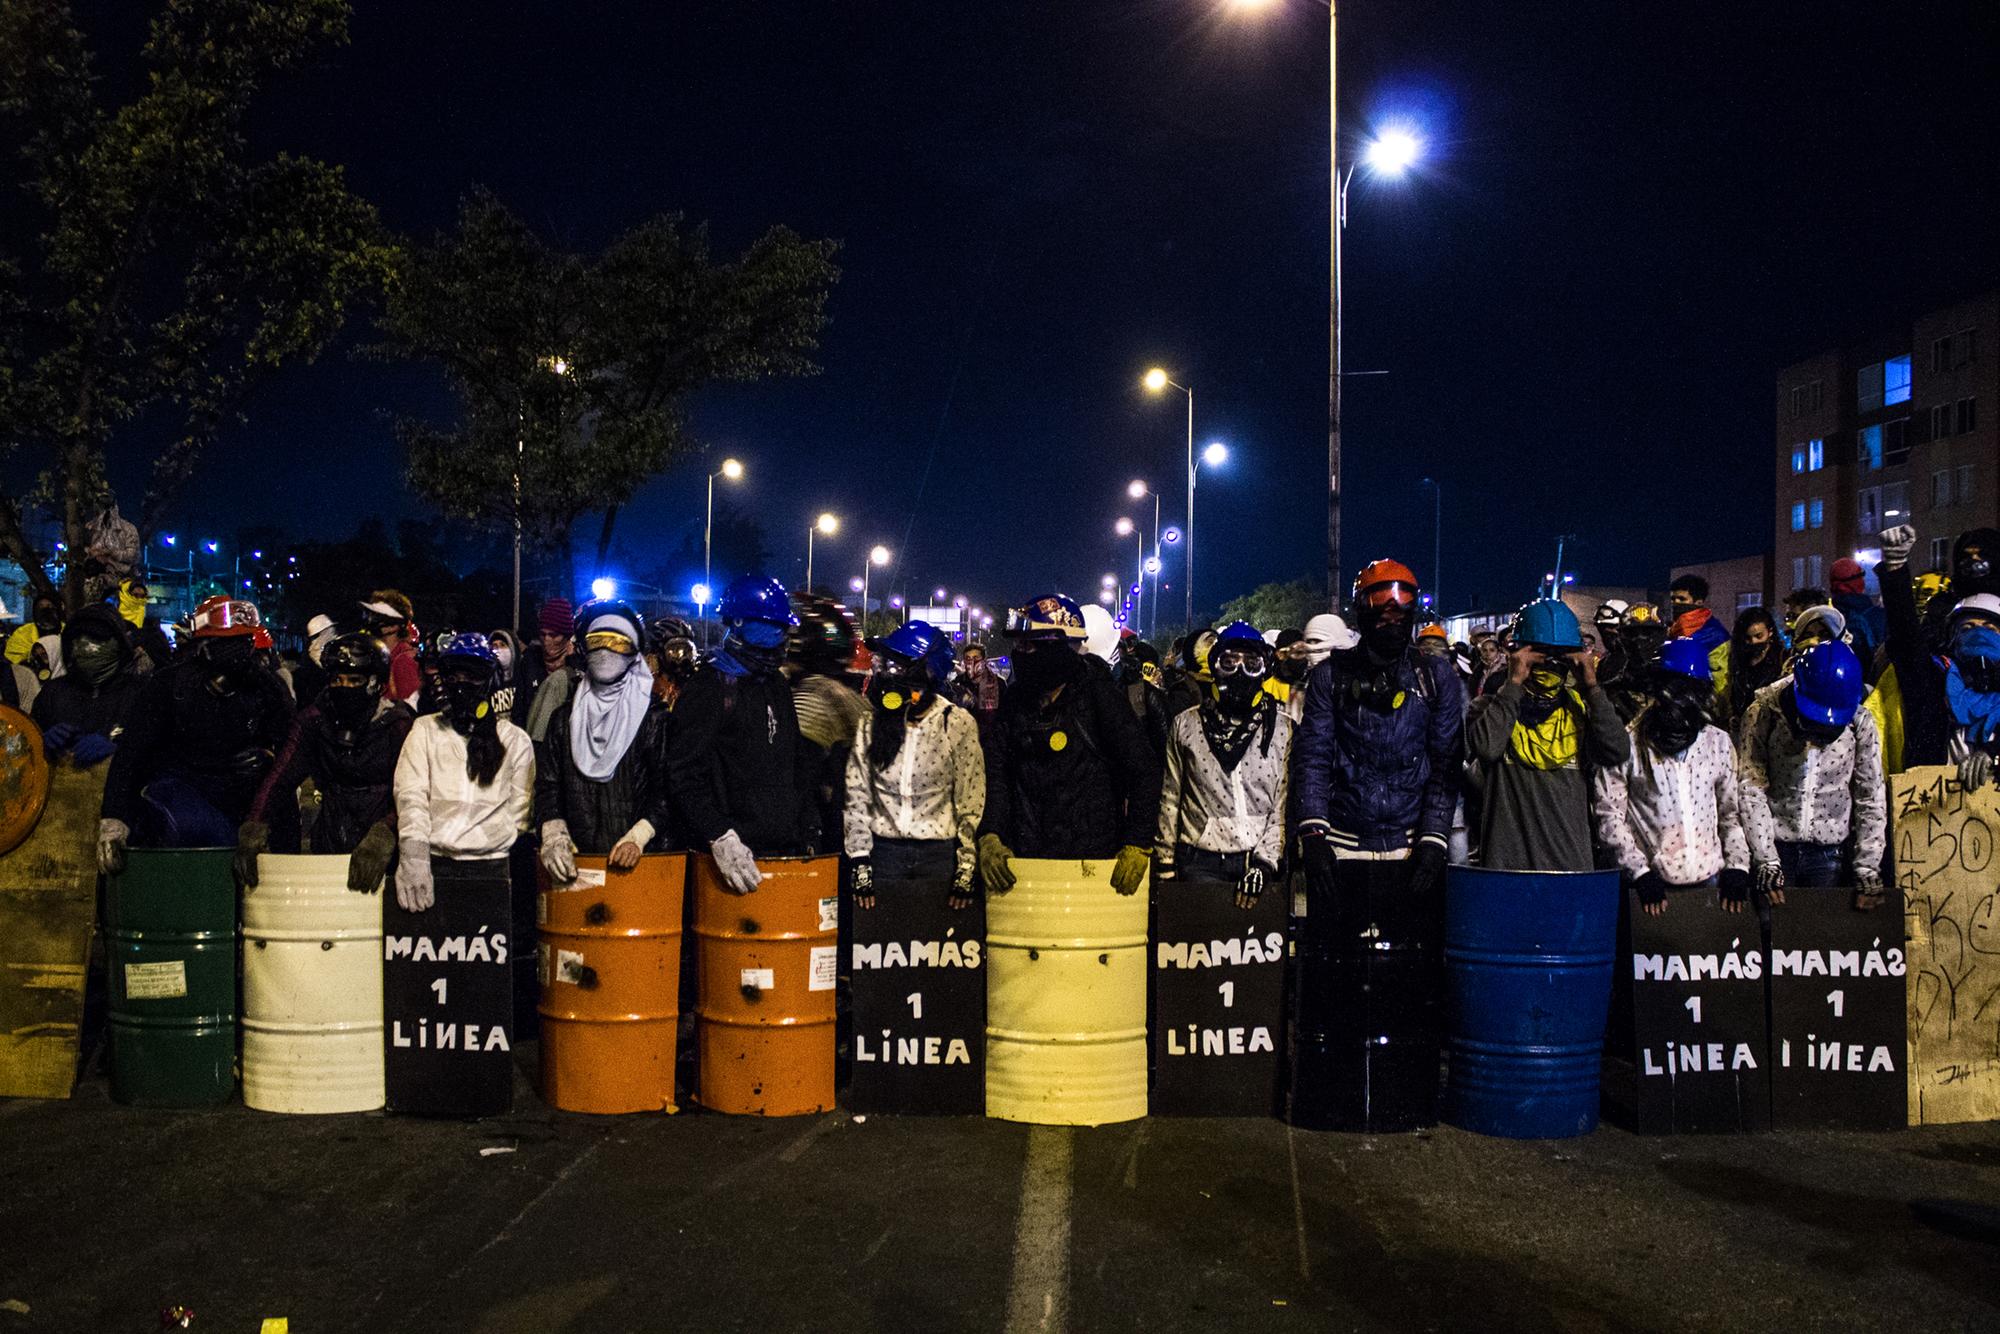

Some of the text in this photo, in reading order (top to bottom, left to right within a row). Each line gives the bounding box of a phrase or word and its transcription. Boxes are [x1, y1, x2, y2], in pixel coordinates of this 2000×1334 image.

[385, 925, 508, 965] MAMÁS
[852, 927, 981, 970] MAMÁS
[1157, 925, 1284, 970] MAMÁS
[1633, 936, 1763, 981] MAMÁS
[1771, 936, 1908, 978] MAMÁS
[430, 978, 447, 1005] 1
[906, 992, 922, 1019] 1
[1218, 980, 1234, 1008] 1
[1826, 989, 1844, 1018] 1
[1684, 995, 1702, 1023] 1
